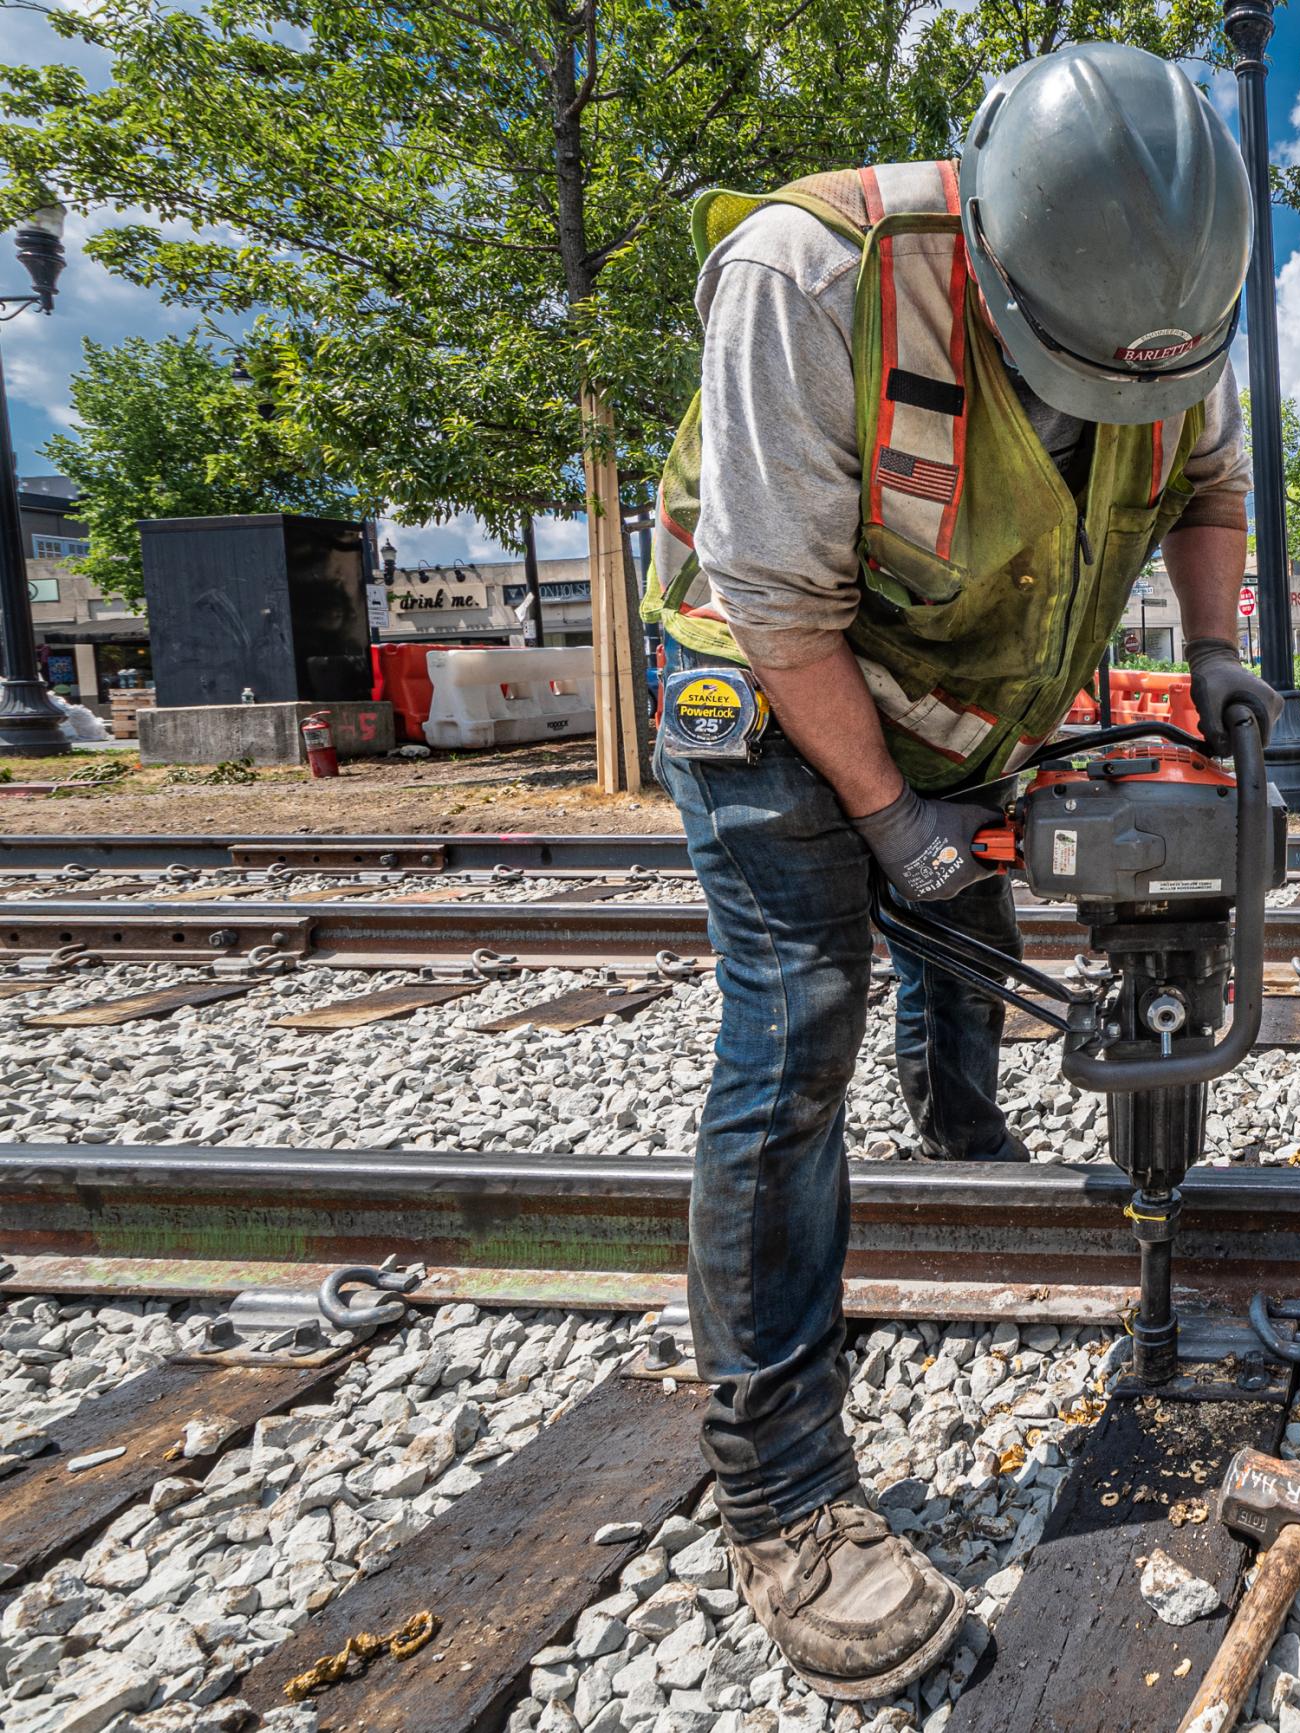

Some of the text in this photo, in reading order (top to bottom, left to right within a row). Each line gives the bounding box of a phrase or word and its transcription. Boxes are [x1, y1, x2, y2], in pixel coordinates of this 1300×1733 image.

[1124, 340, 1194, 361] BARLETTA
[400, 588, 444, 610] drink
[451, 594, 480, 607] me.
[688, 694, 730, 703] STANLEY
[919, 857, 964, 895] MaxiFlex
